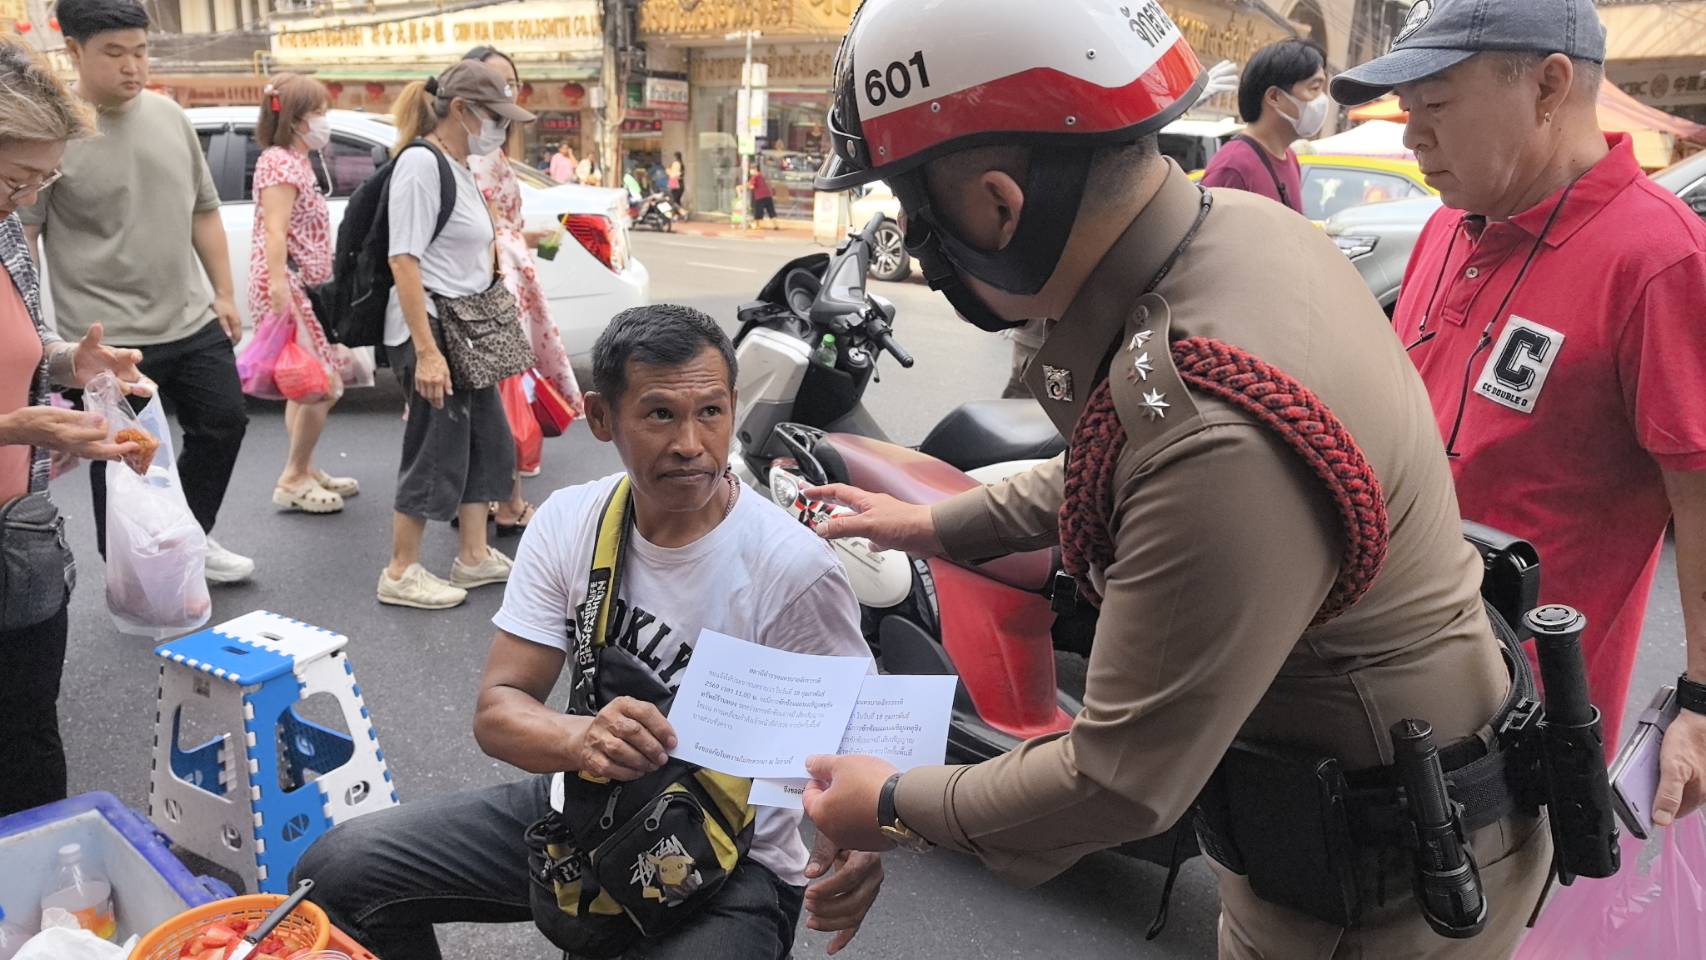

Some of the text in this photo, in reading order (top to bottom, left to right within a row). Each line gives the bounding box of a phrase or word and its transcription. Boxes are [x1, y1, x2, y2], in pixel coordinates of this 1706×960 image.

[865, 50, 930, 106] 601
[1494, 327, 1550, 391] C
[1482, 382, 1492, 392] CC
[1492, 388, 1520, 405] DOUBLE
[705, 680, 719, 690] 2569
